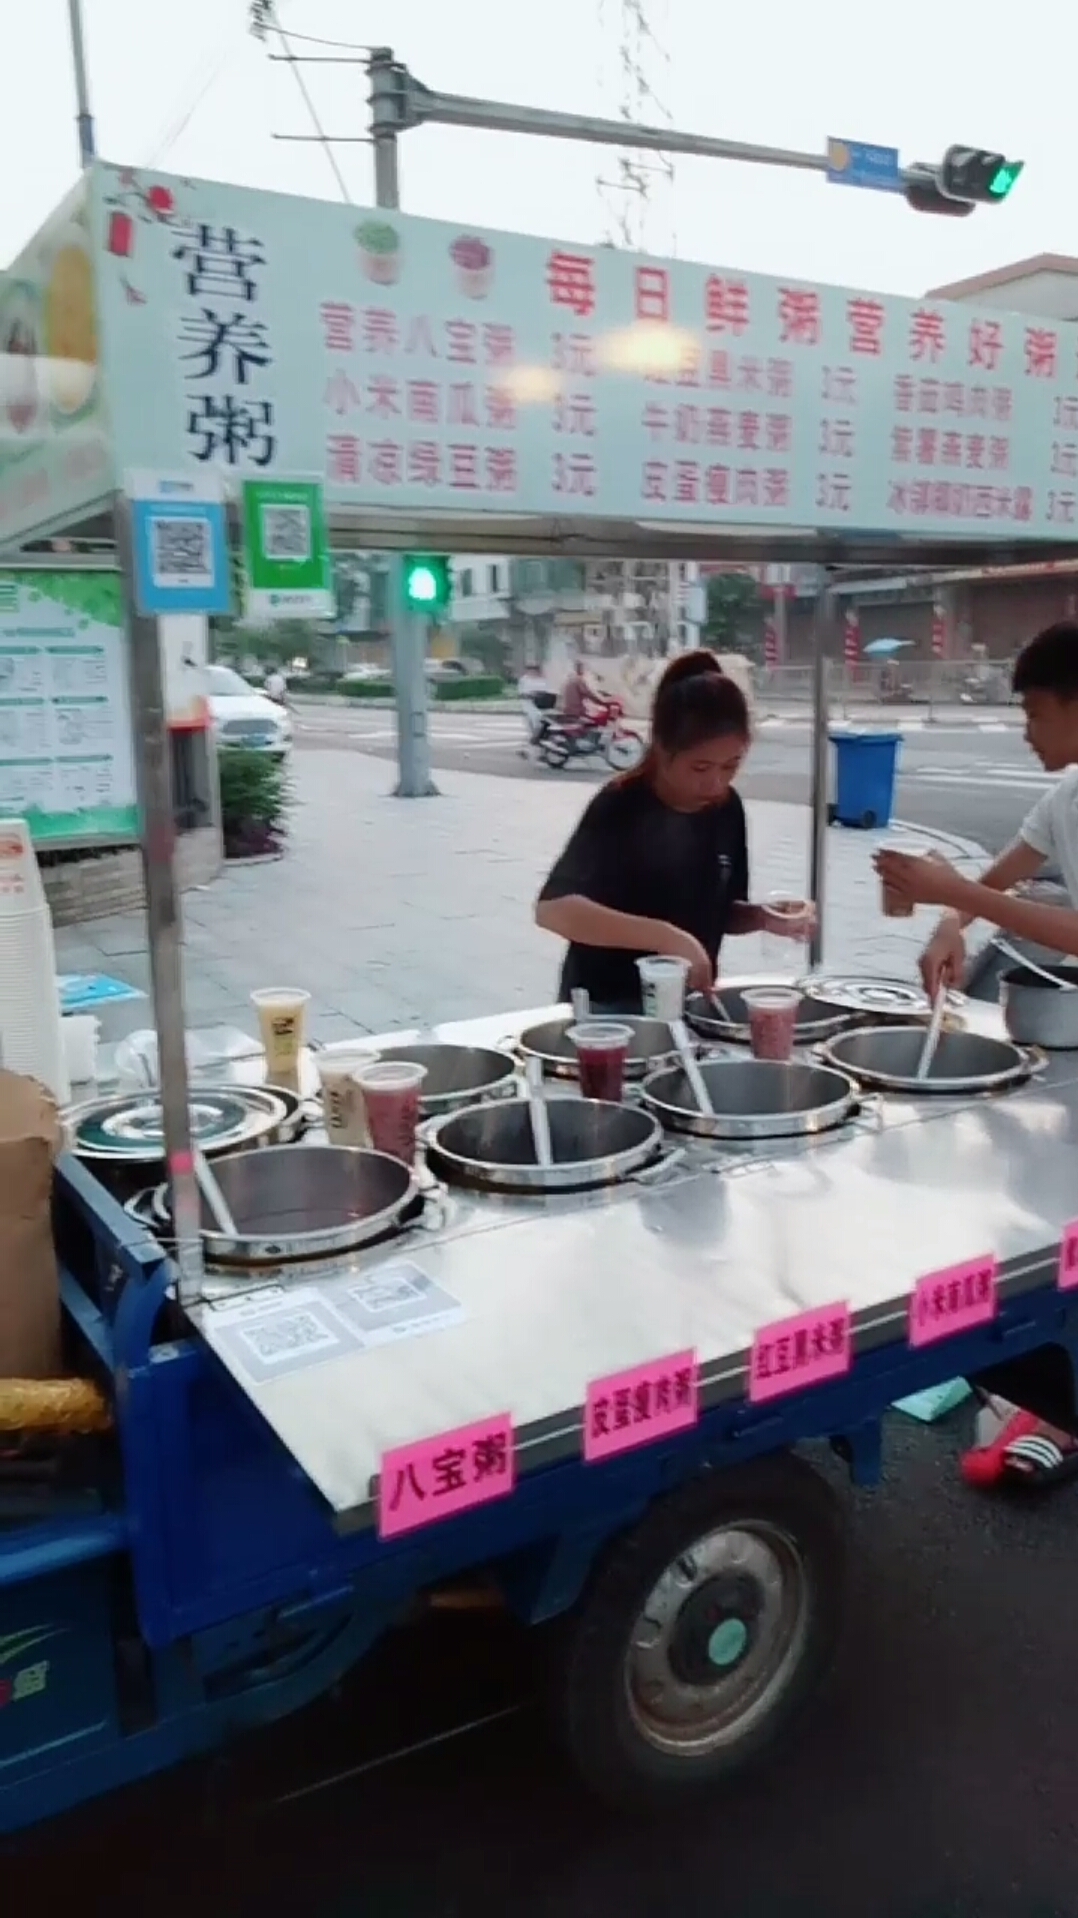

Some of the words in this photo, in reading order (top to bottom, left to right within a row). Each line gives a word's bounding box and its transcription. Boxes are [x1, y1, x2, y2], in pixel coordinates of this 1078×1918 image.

[170, 223, 277, 467] 营养粥
[320, 301, 515, 367] 营养八宝粥
[546, 248, 1078, 378] 每日鲜粥营养好粥
[322, 368, 517, 430] 小米南瓜粥
[551, 393, 598, 437] 3元
[642, 340, 793, 398] 豆黑米粥
[821, 365, 857, 403] 3元
[819, 418, 854, 458] 3元
[551, 452, 598, 497] 3元
[641, 459, 789, 507] 皮蛋瘦肉粥
[815, 472, 852, 511] 3元
[1046, 489, 1077, 523] 3元
[592, 1368, 692, 1439] 皮蛋瘦肉粥
[388, 1431, 507, 1512] 八宝粥
